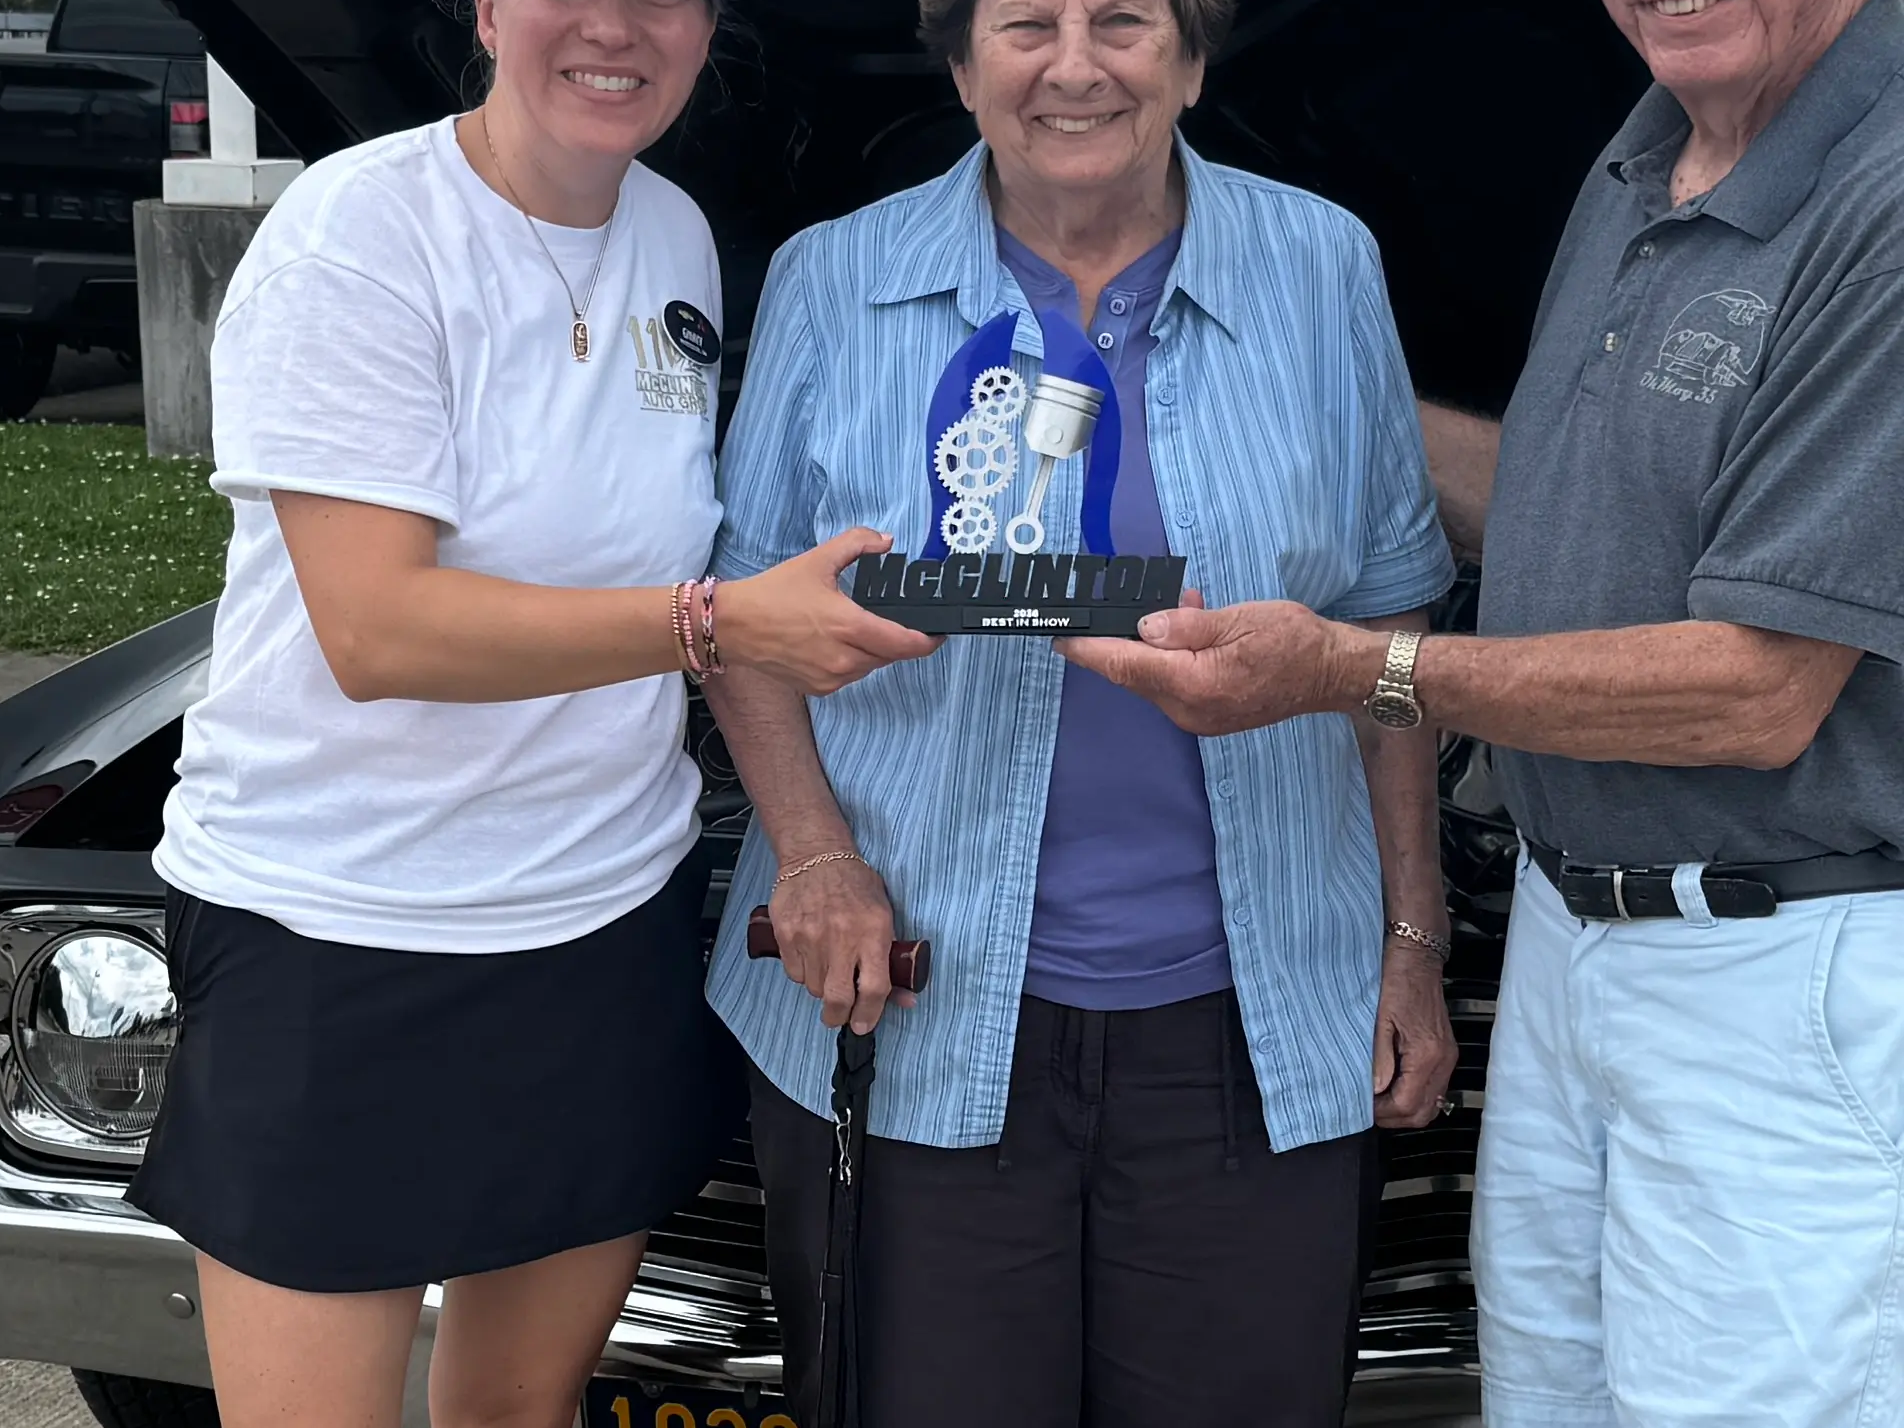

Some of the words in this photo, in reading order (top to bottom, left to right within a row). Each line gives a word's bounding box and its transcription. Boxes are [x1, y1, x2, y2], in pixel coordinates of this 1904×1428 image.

[643, 391, 675, 409] AUTO
[853, 553, 1188, 600] McCLINTON
[1016, 618, 1030, 627] IN
